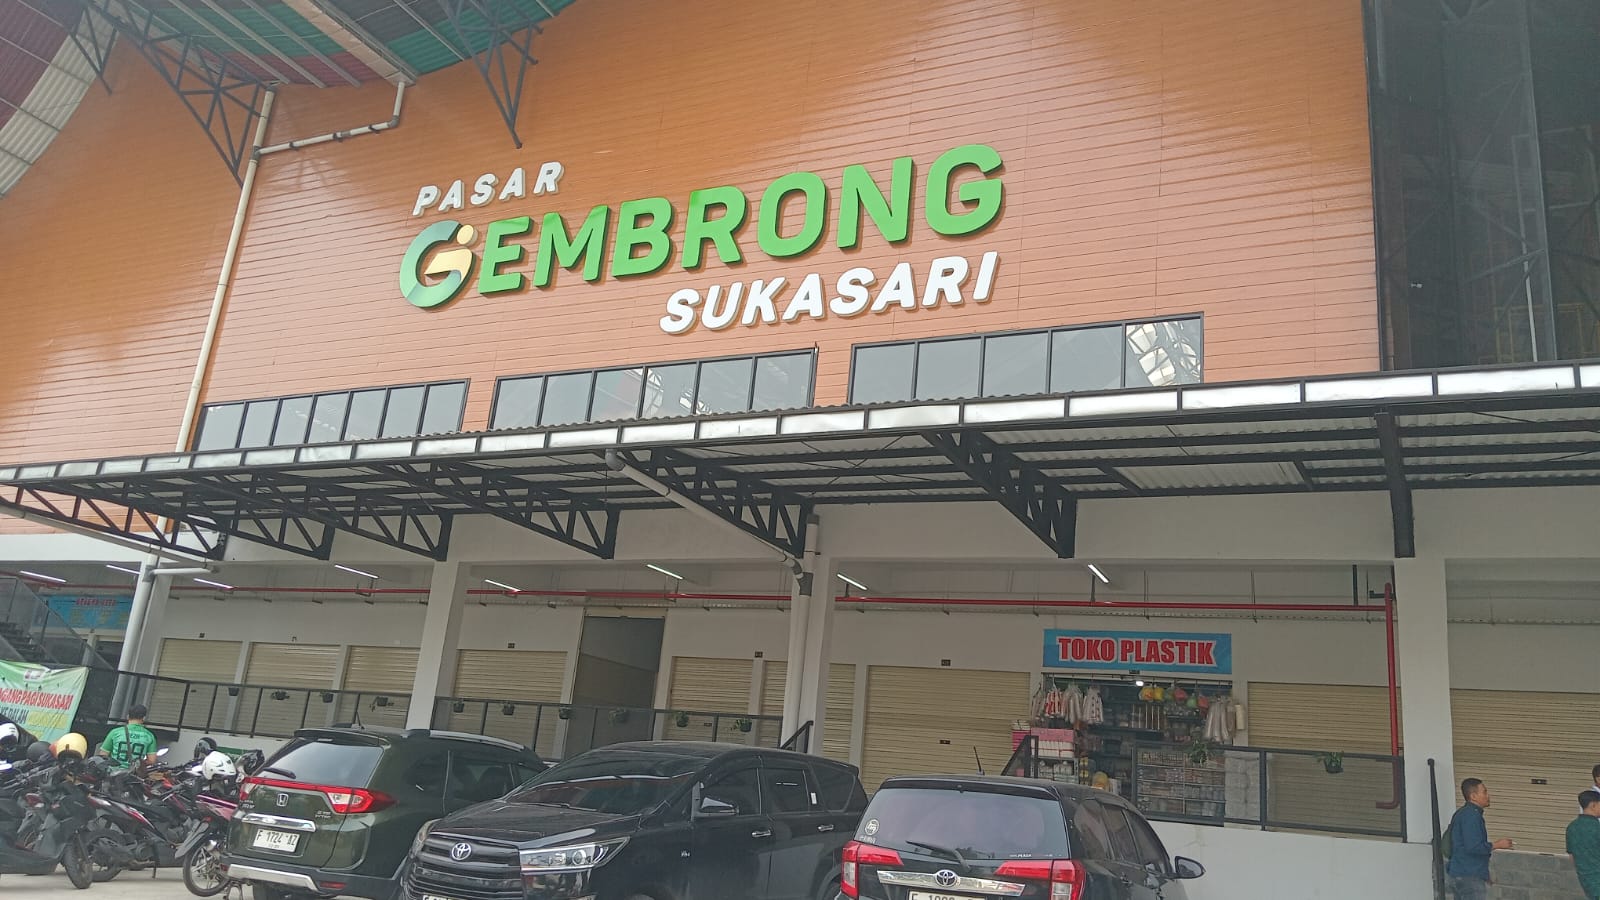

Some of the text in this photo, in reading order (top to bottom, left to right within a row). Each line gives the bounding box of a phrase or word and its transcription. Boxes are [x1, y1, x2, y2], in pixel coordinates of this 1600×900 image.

[412, 161, 565, 217] PASAR
[399, 143, 1004, 308] GEMBRONG
[659, 251, 999, 335] SUKASARI
[1057, 636, 1215, 666] TOKO PLASTIK
[36, 691, 74, 711] SUKASARI
[256, 830, 263, 840] F
